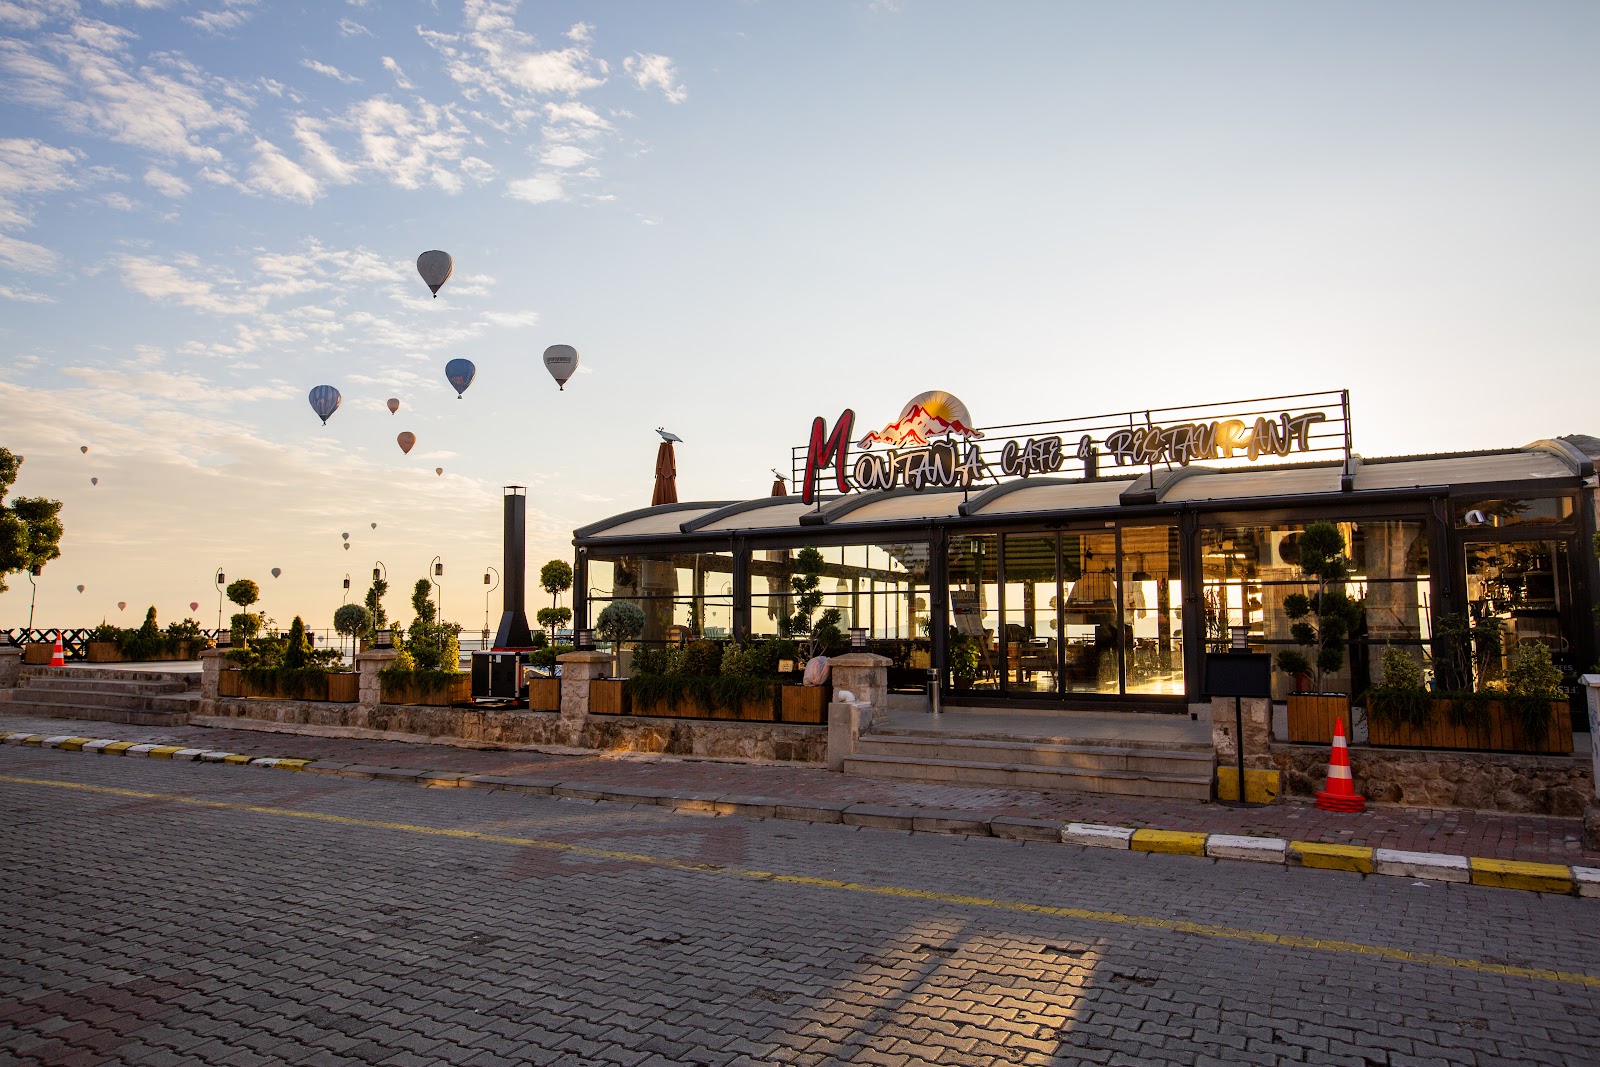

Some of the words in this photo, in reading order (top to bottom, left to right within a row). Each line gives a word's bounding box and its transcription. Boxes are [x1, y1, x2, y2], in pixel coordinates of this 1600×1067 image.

[802, 408, 983, 505] MONTAÑA
[1002, 436, 1063, 478] CAFE
[1078, 435, 1096, 462] &
[1106, 412, 1325, 466] RESTAURANT
